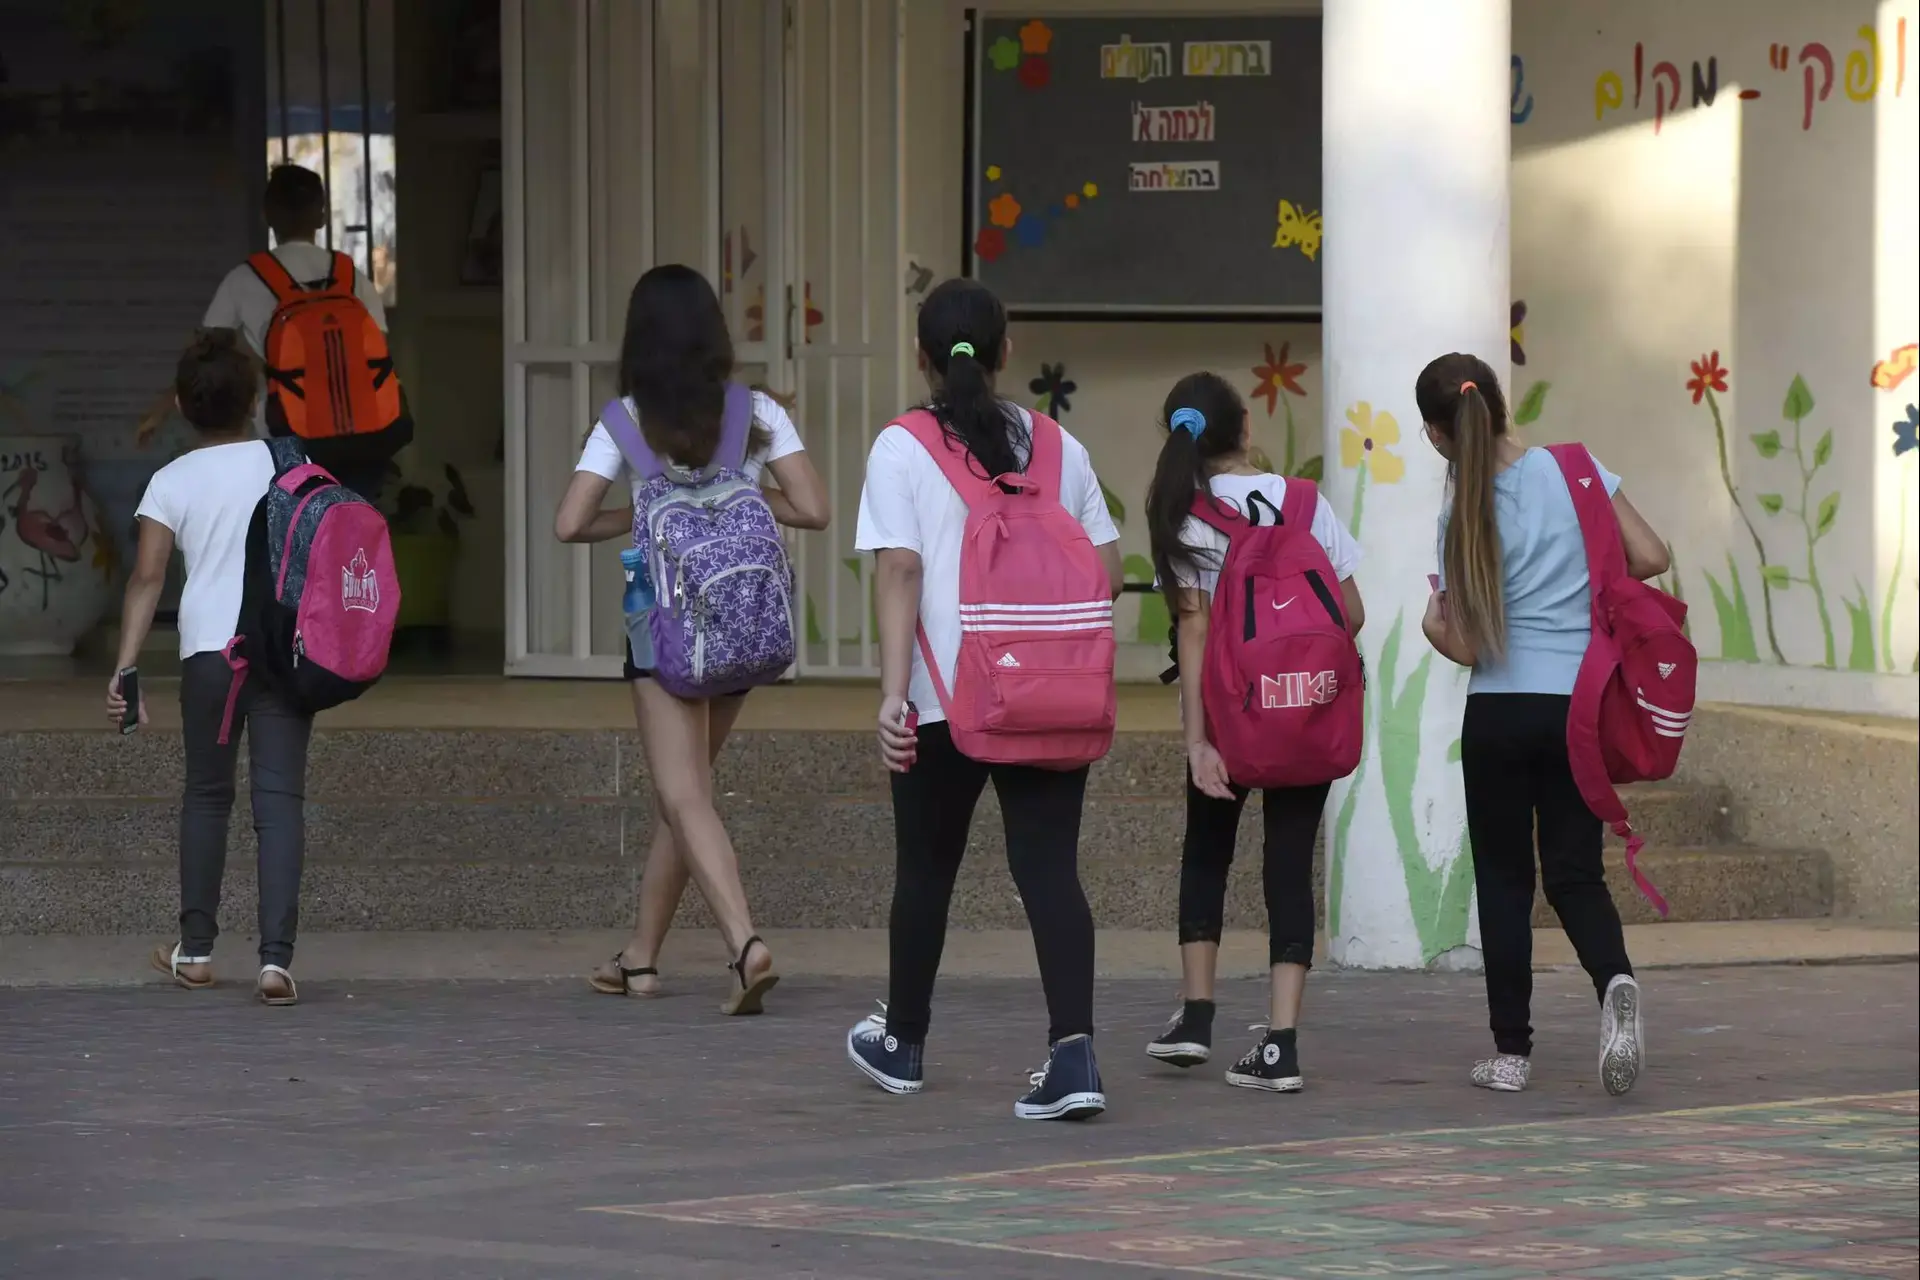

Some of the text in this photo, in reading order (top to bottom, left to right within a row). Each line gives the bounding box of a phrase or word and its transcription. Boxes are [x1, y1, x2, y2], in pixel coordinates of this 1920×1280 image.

[1594, 41, 1718, 136] מקום
[1158, 101, 1212, 140] לכתה
[1261, 670, 1338, 708] NIKE
